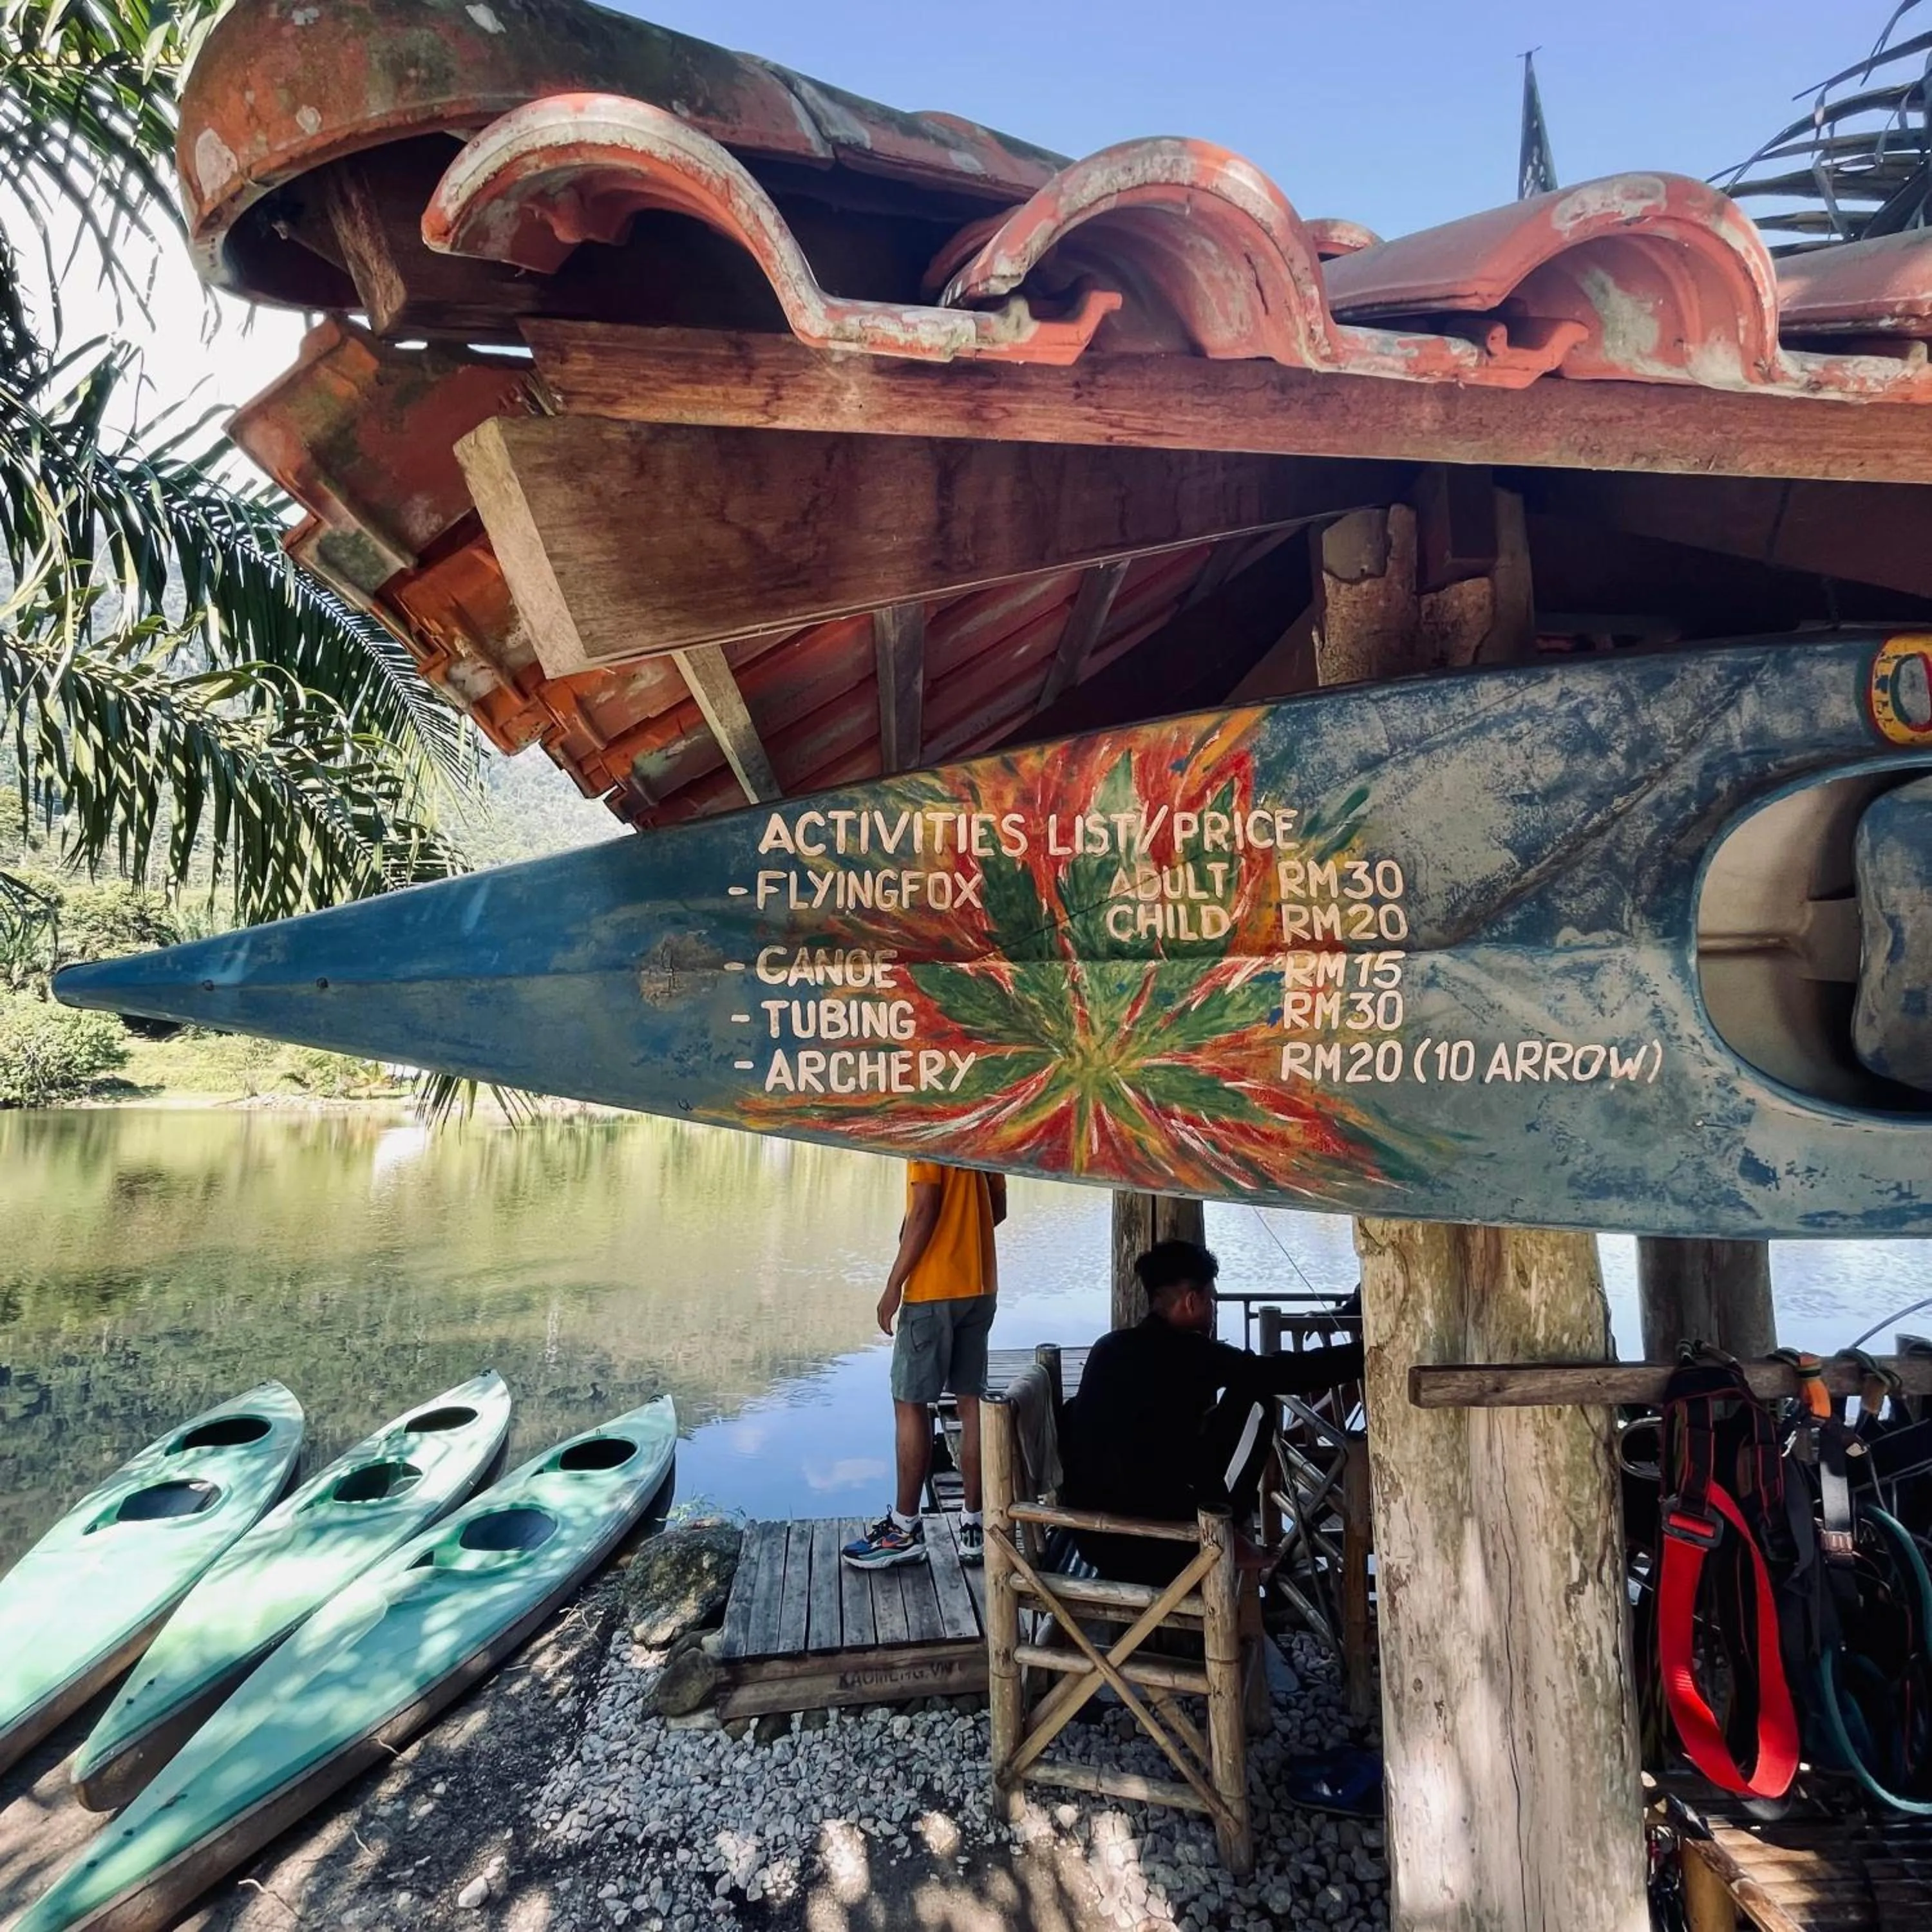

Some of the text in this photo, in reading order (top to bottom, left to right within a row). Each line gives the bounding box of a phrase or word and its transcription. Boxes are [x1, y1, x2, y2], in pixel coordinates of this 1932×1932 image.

[758, 811, 1028, 857] ACTIVITIES
[1109, 862, 1229, 901] ADULT
[1106, 904, 1232, 942] CHILD
[1484, 1039, 1663, 1084] ARROW)
